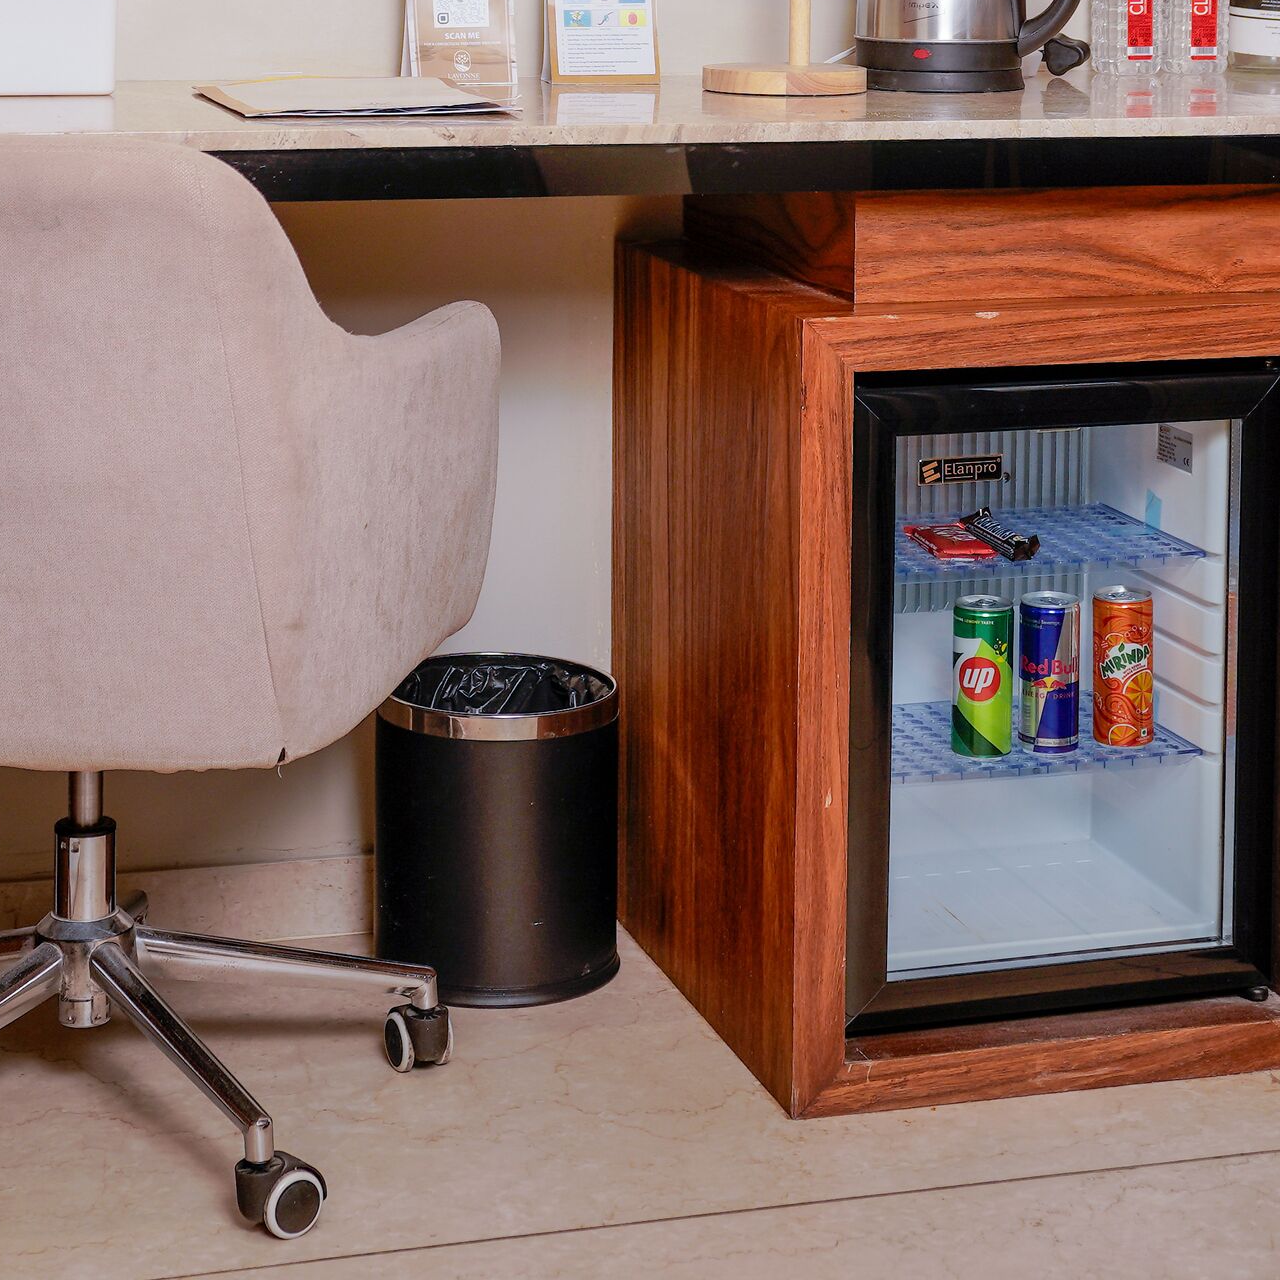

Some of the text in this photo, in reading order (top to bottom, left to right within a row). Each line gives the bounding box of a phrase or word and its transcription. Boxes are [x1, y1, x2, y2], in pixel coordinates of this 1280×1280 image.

[444, 31, 481, 40] SCAN ME
[944, 462, 997, 480] Elanpro
[1022, 655, 1049, 675] Red
[1100, 644, 1151, 678] MIRINDA
